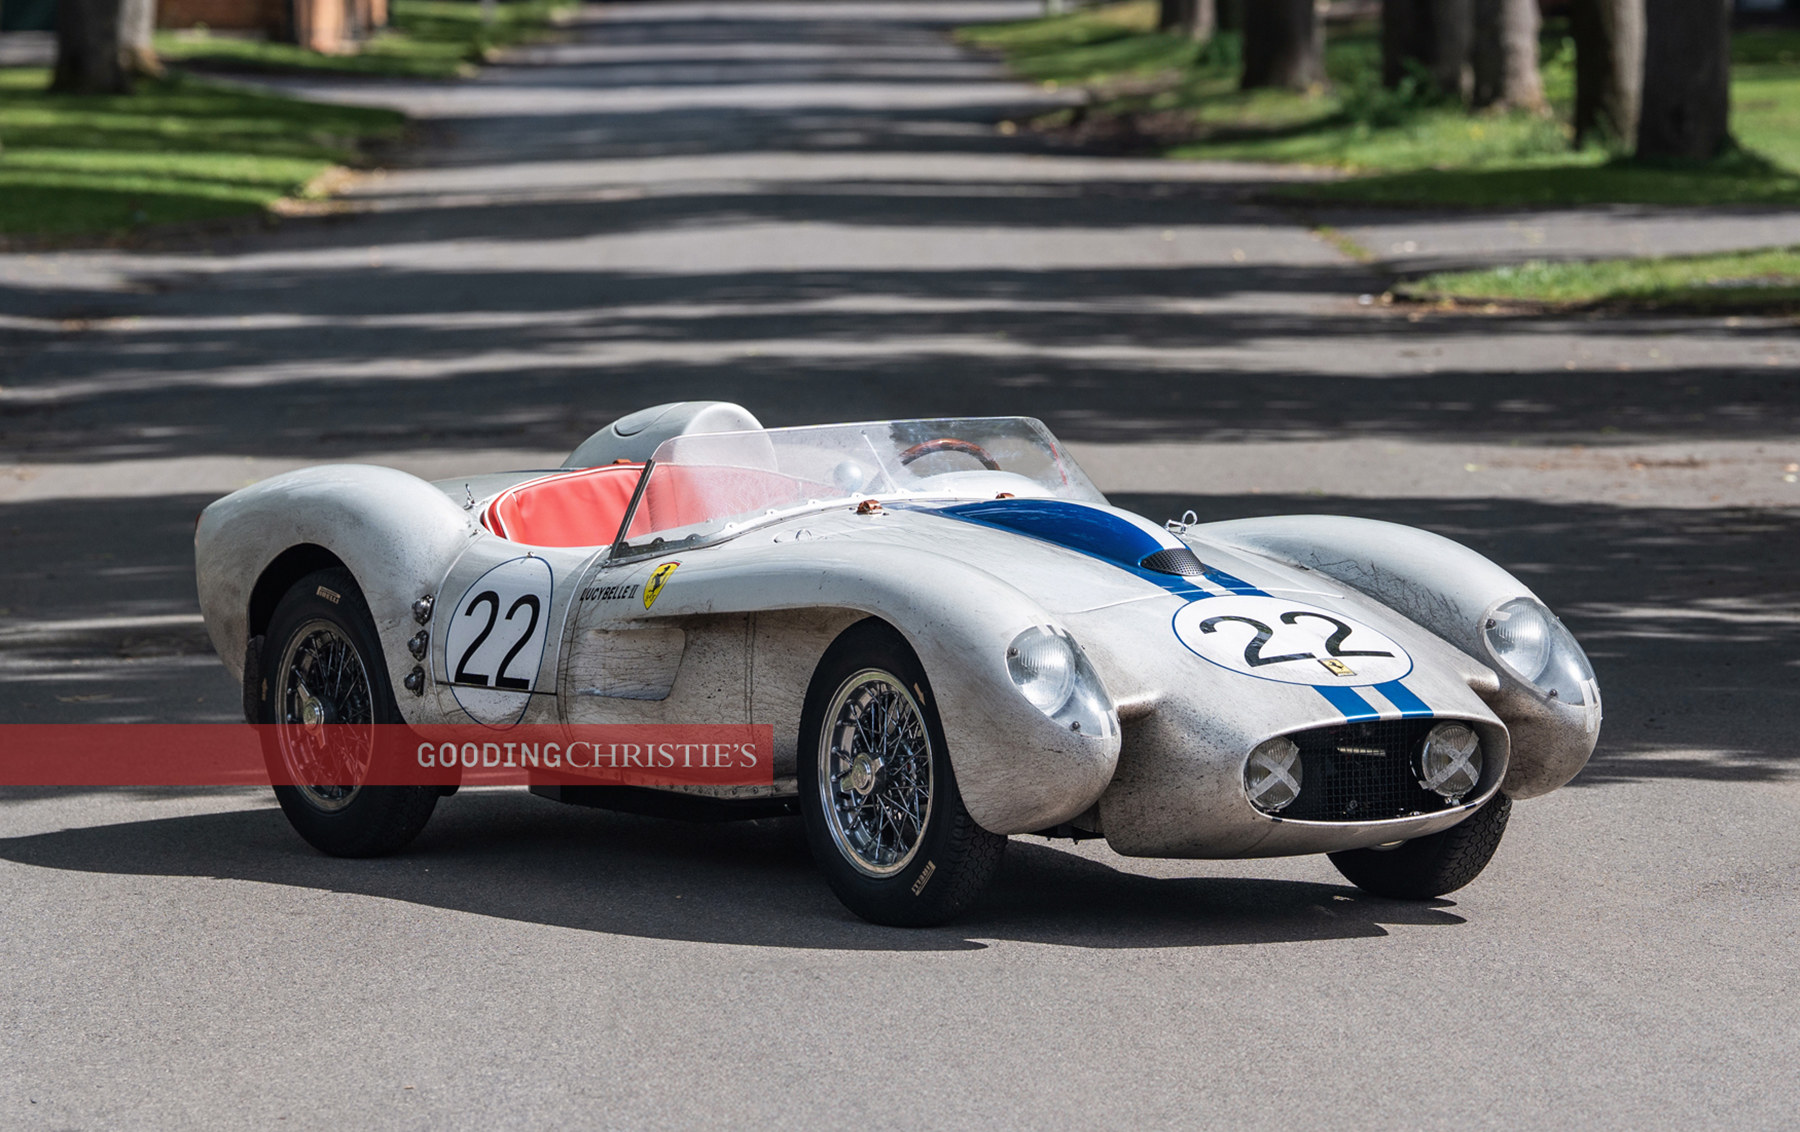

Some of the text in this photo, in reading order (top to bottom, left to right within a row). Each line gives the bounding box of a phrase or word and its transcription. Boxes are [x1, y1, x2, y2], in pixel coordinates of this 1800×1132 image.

[580, 586, 631, 601] LUCYBELLE
[628, 584, 640, 599] II
[454, 590, 541, 690] 22
[1199, 611, 1396, 668] 22
[911, 860, 936, 896] PIRELLI
